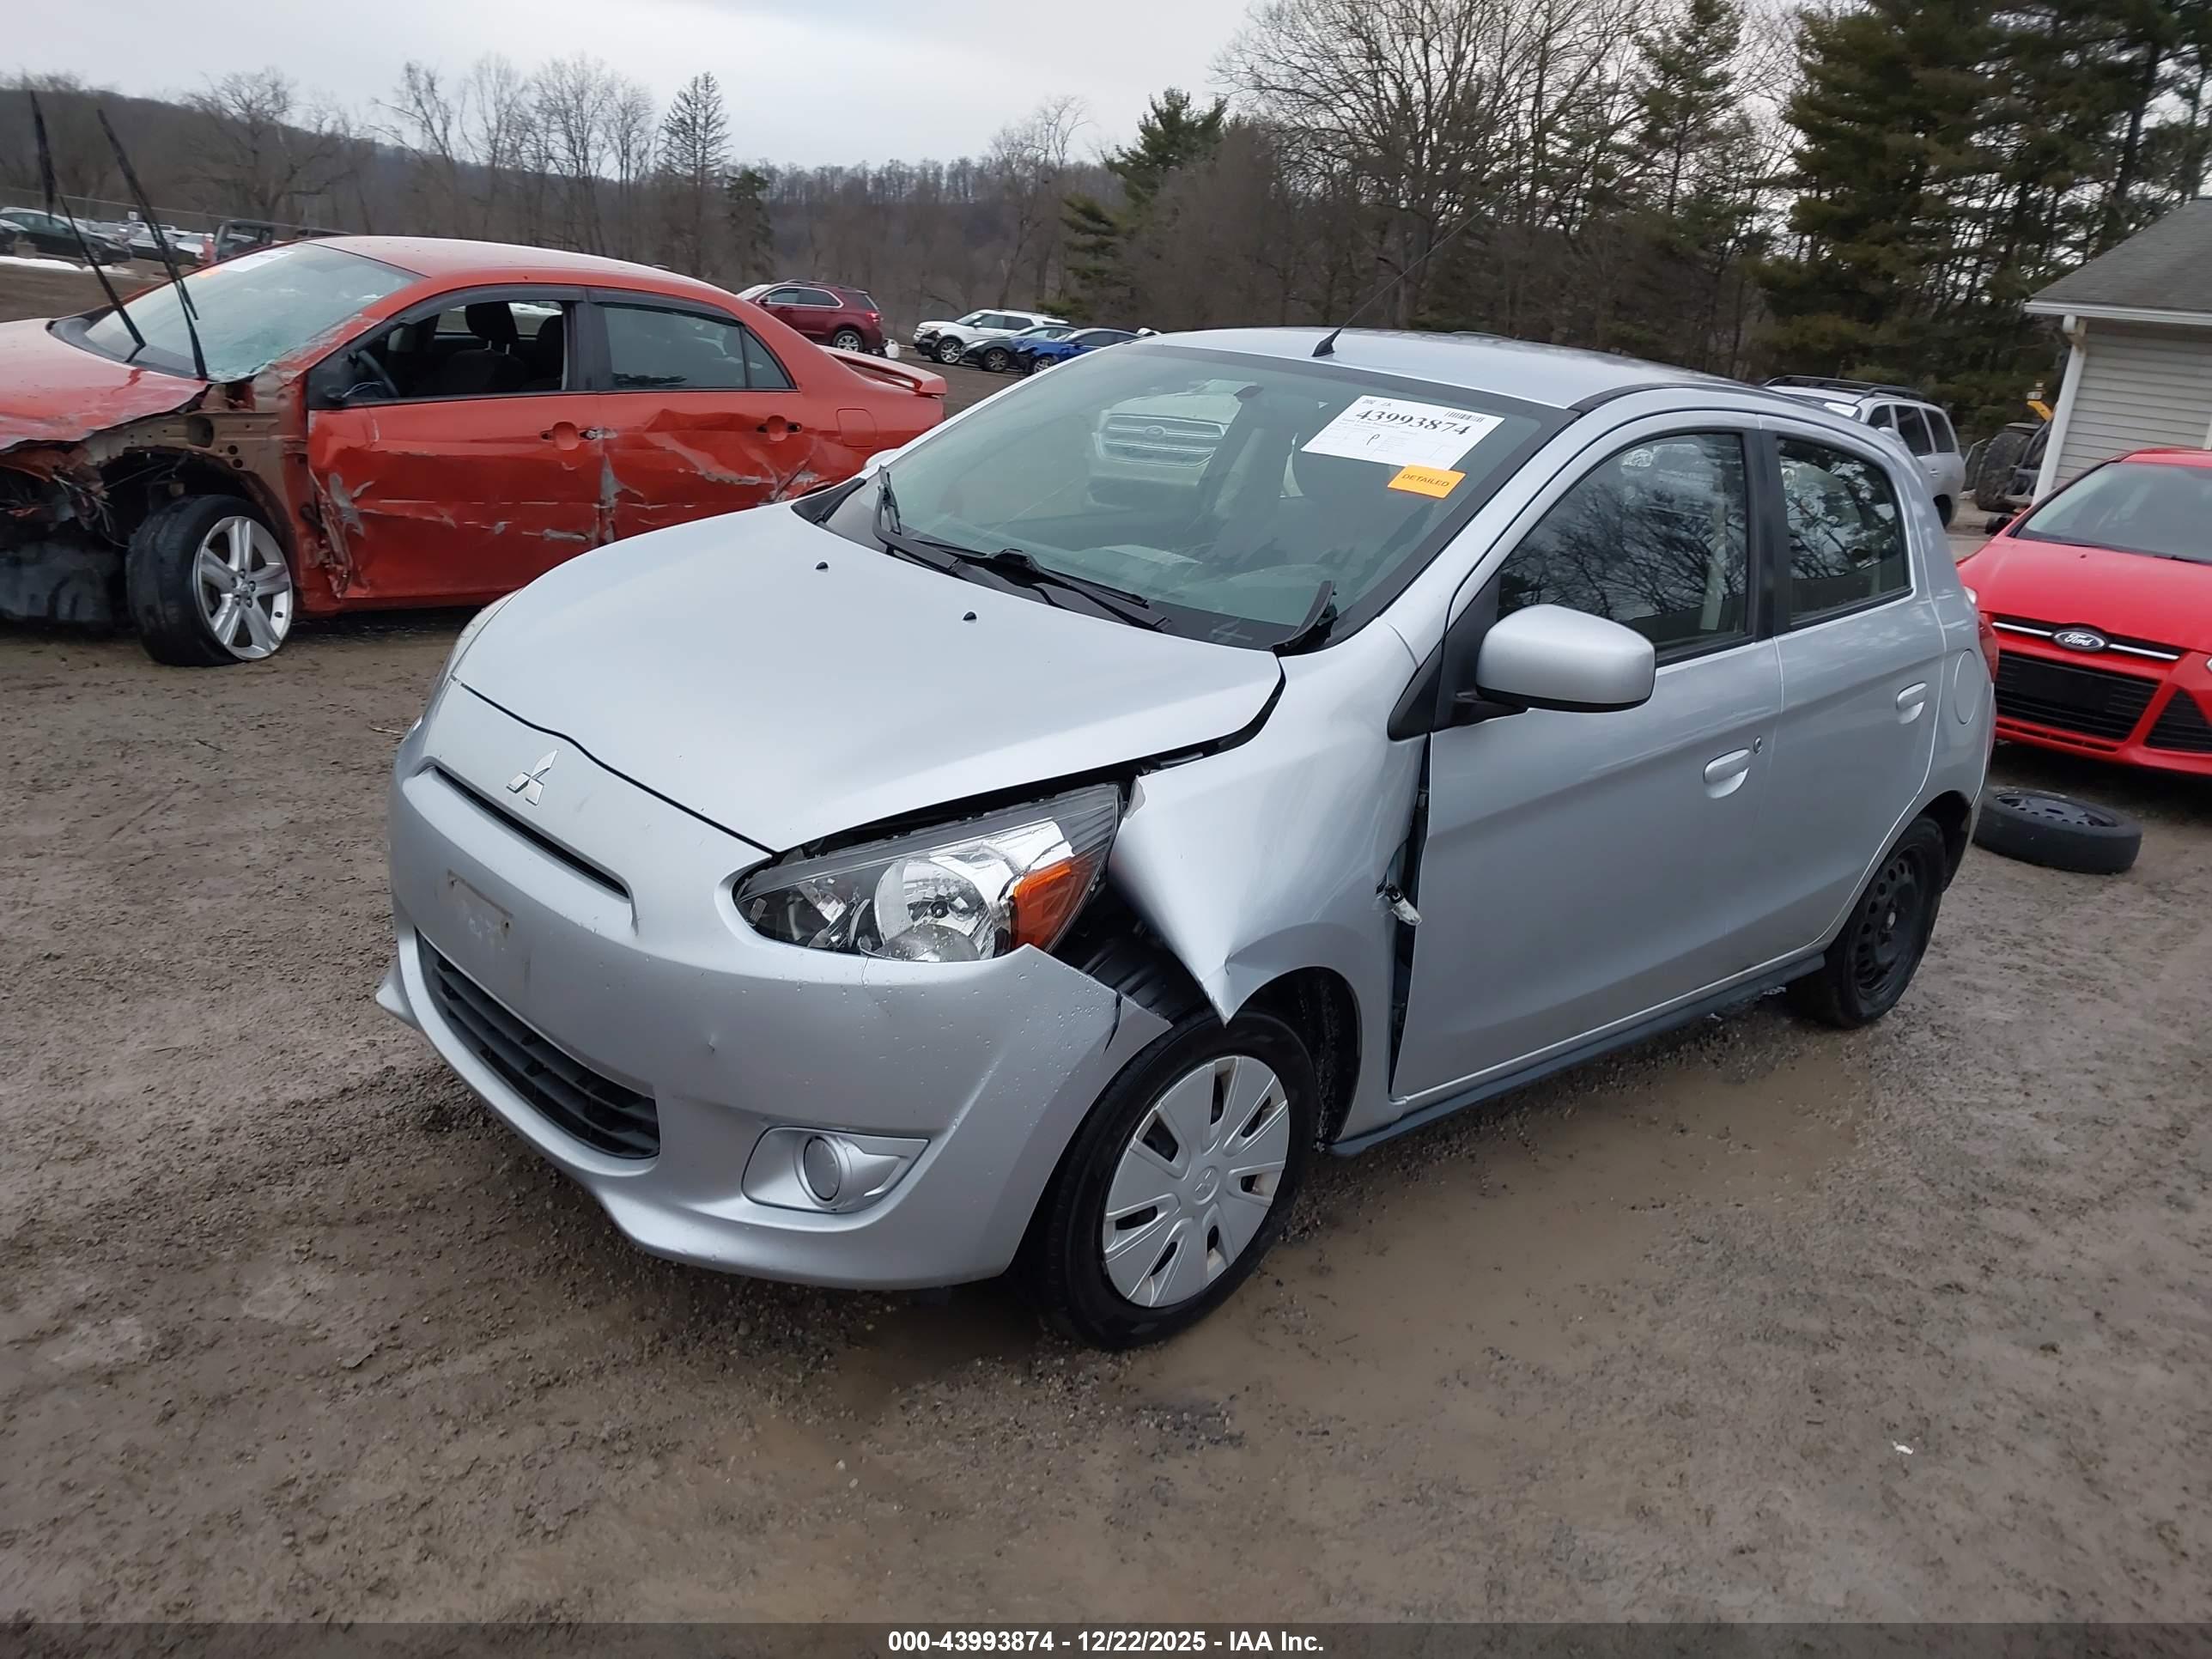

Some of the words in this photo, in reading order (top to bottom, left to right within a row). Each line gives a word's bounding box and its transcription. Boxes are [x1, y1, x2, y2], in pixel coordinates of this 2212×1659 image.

[1356, 410, 1472, 435] 43993874
[1401, 473, 1450, 488] DETAILED
[2064, 633, 2094, 647] Ford
